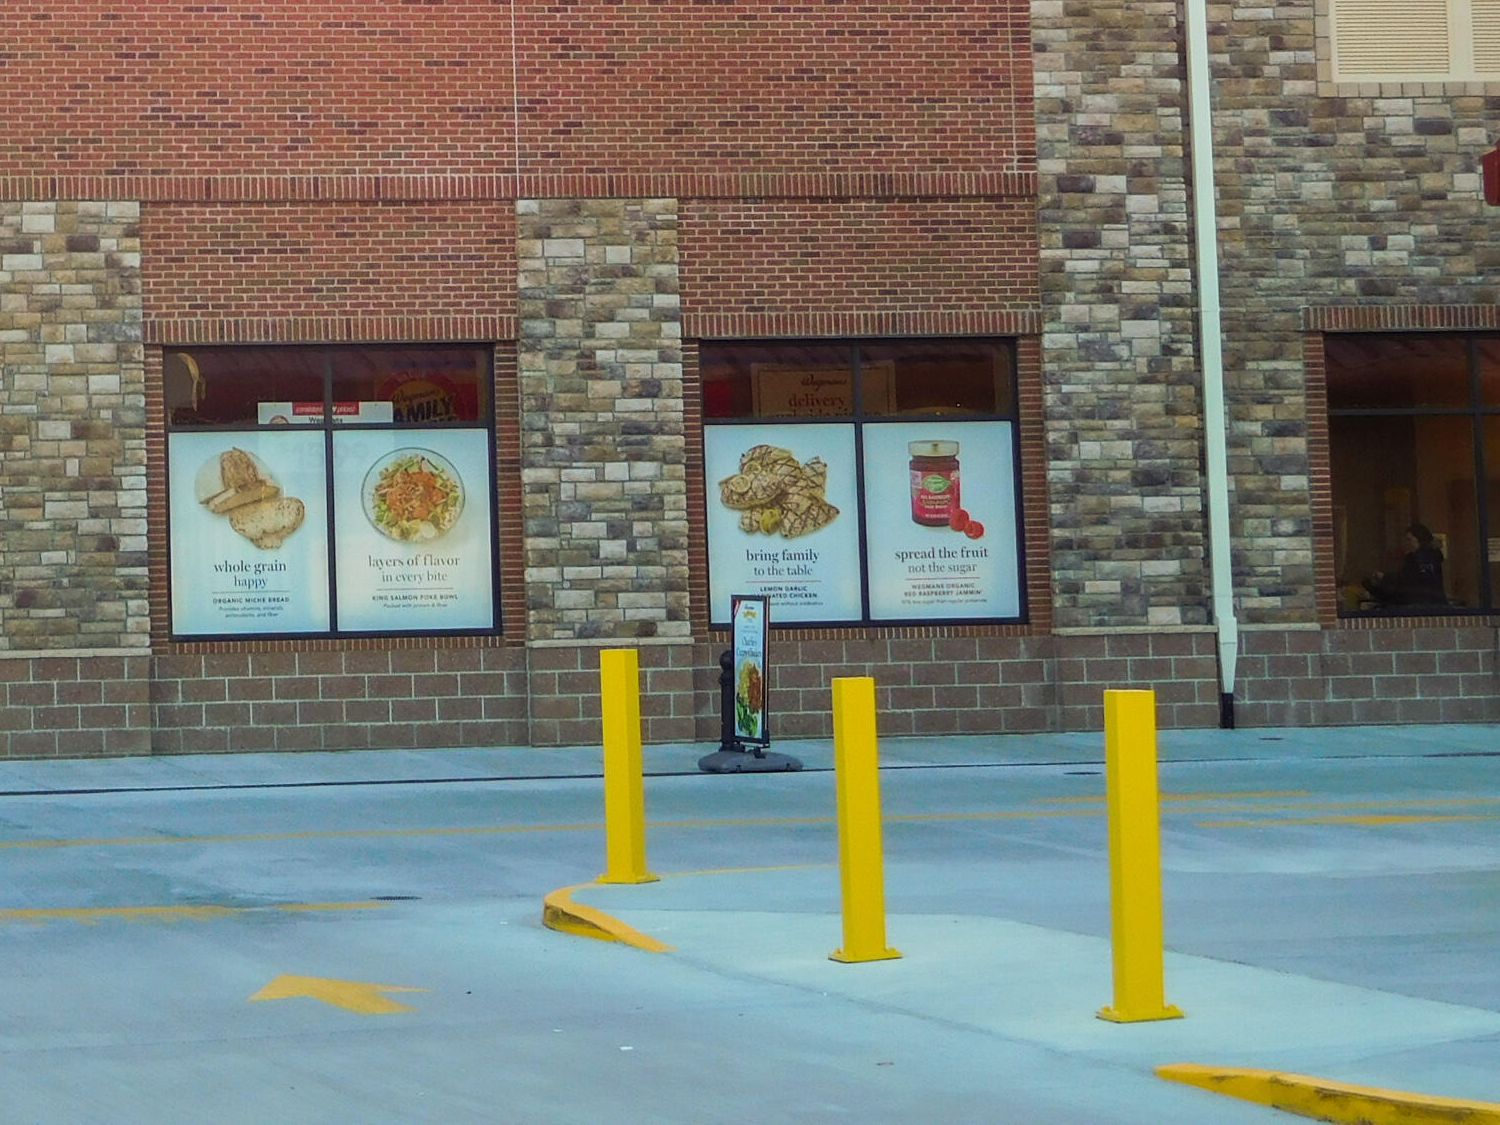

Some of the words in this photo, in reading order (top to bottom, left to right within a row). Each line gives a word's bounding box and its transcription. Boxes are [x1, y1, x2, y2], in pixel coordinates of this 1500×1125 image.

[393, 395, 454, 422] AMILY
[788, 393, 845, 409] delivery
[368, 555, 404, 571] layers
[407, 554, 421, 566] of
[424, 553, 460, 566] flavor
[746, 549, 780, 564] bring
[782, 548, 820, 564] family
[894, 546, 935, 563] spread
[938, 546, 958, 559] the
[961, 546, 988, 558] fruit
[214, 559, 251, 573] whole
[254, 559, 287, 575] grain
[754, 567, 765, 576] to
[767, 565, 784, 576] the
[787, 564, 813, 576] table
[908, 564, 926, 573] not
[928, 561, 945, 573] the
[948, 563, 978, 575] sugar
[234, 575, 268, 590] happy
[382, 571, 393, 582] in
[395, 573, 422, 585] every
[427, 570, 448, 581] bite
